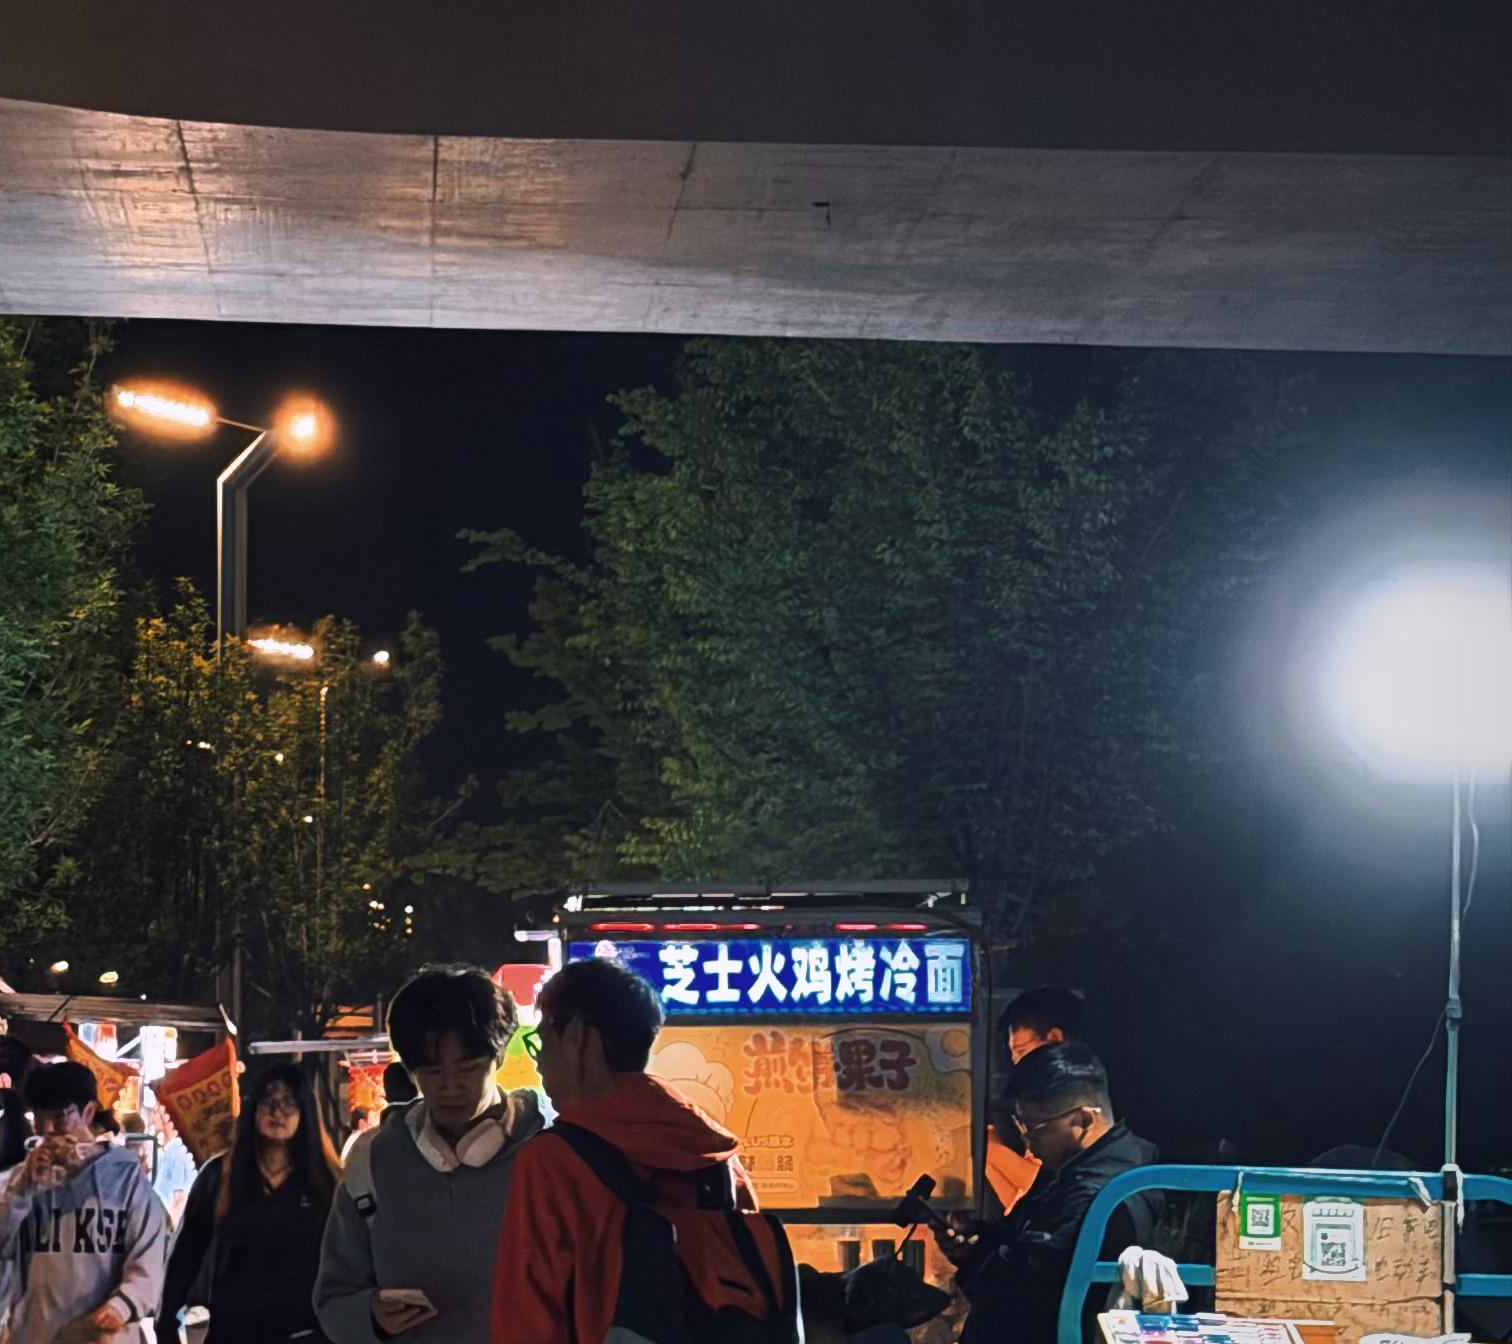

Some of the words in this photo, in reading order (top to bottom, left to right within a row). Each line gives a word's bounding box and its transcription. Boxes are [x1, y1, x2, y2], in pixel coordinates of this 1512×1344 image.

[659, 940, 965, 1005] 芝士火鸡烤冷面
